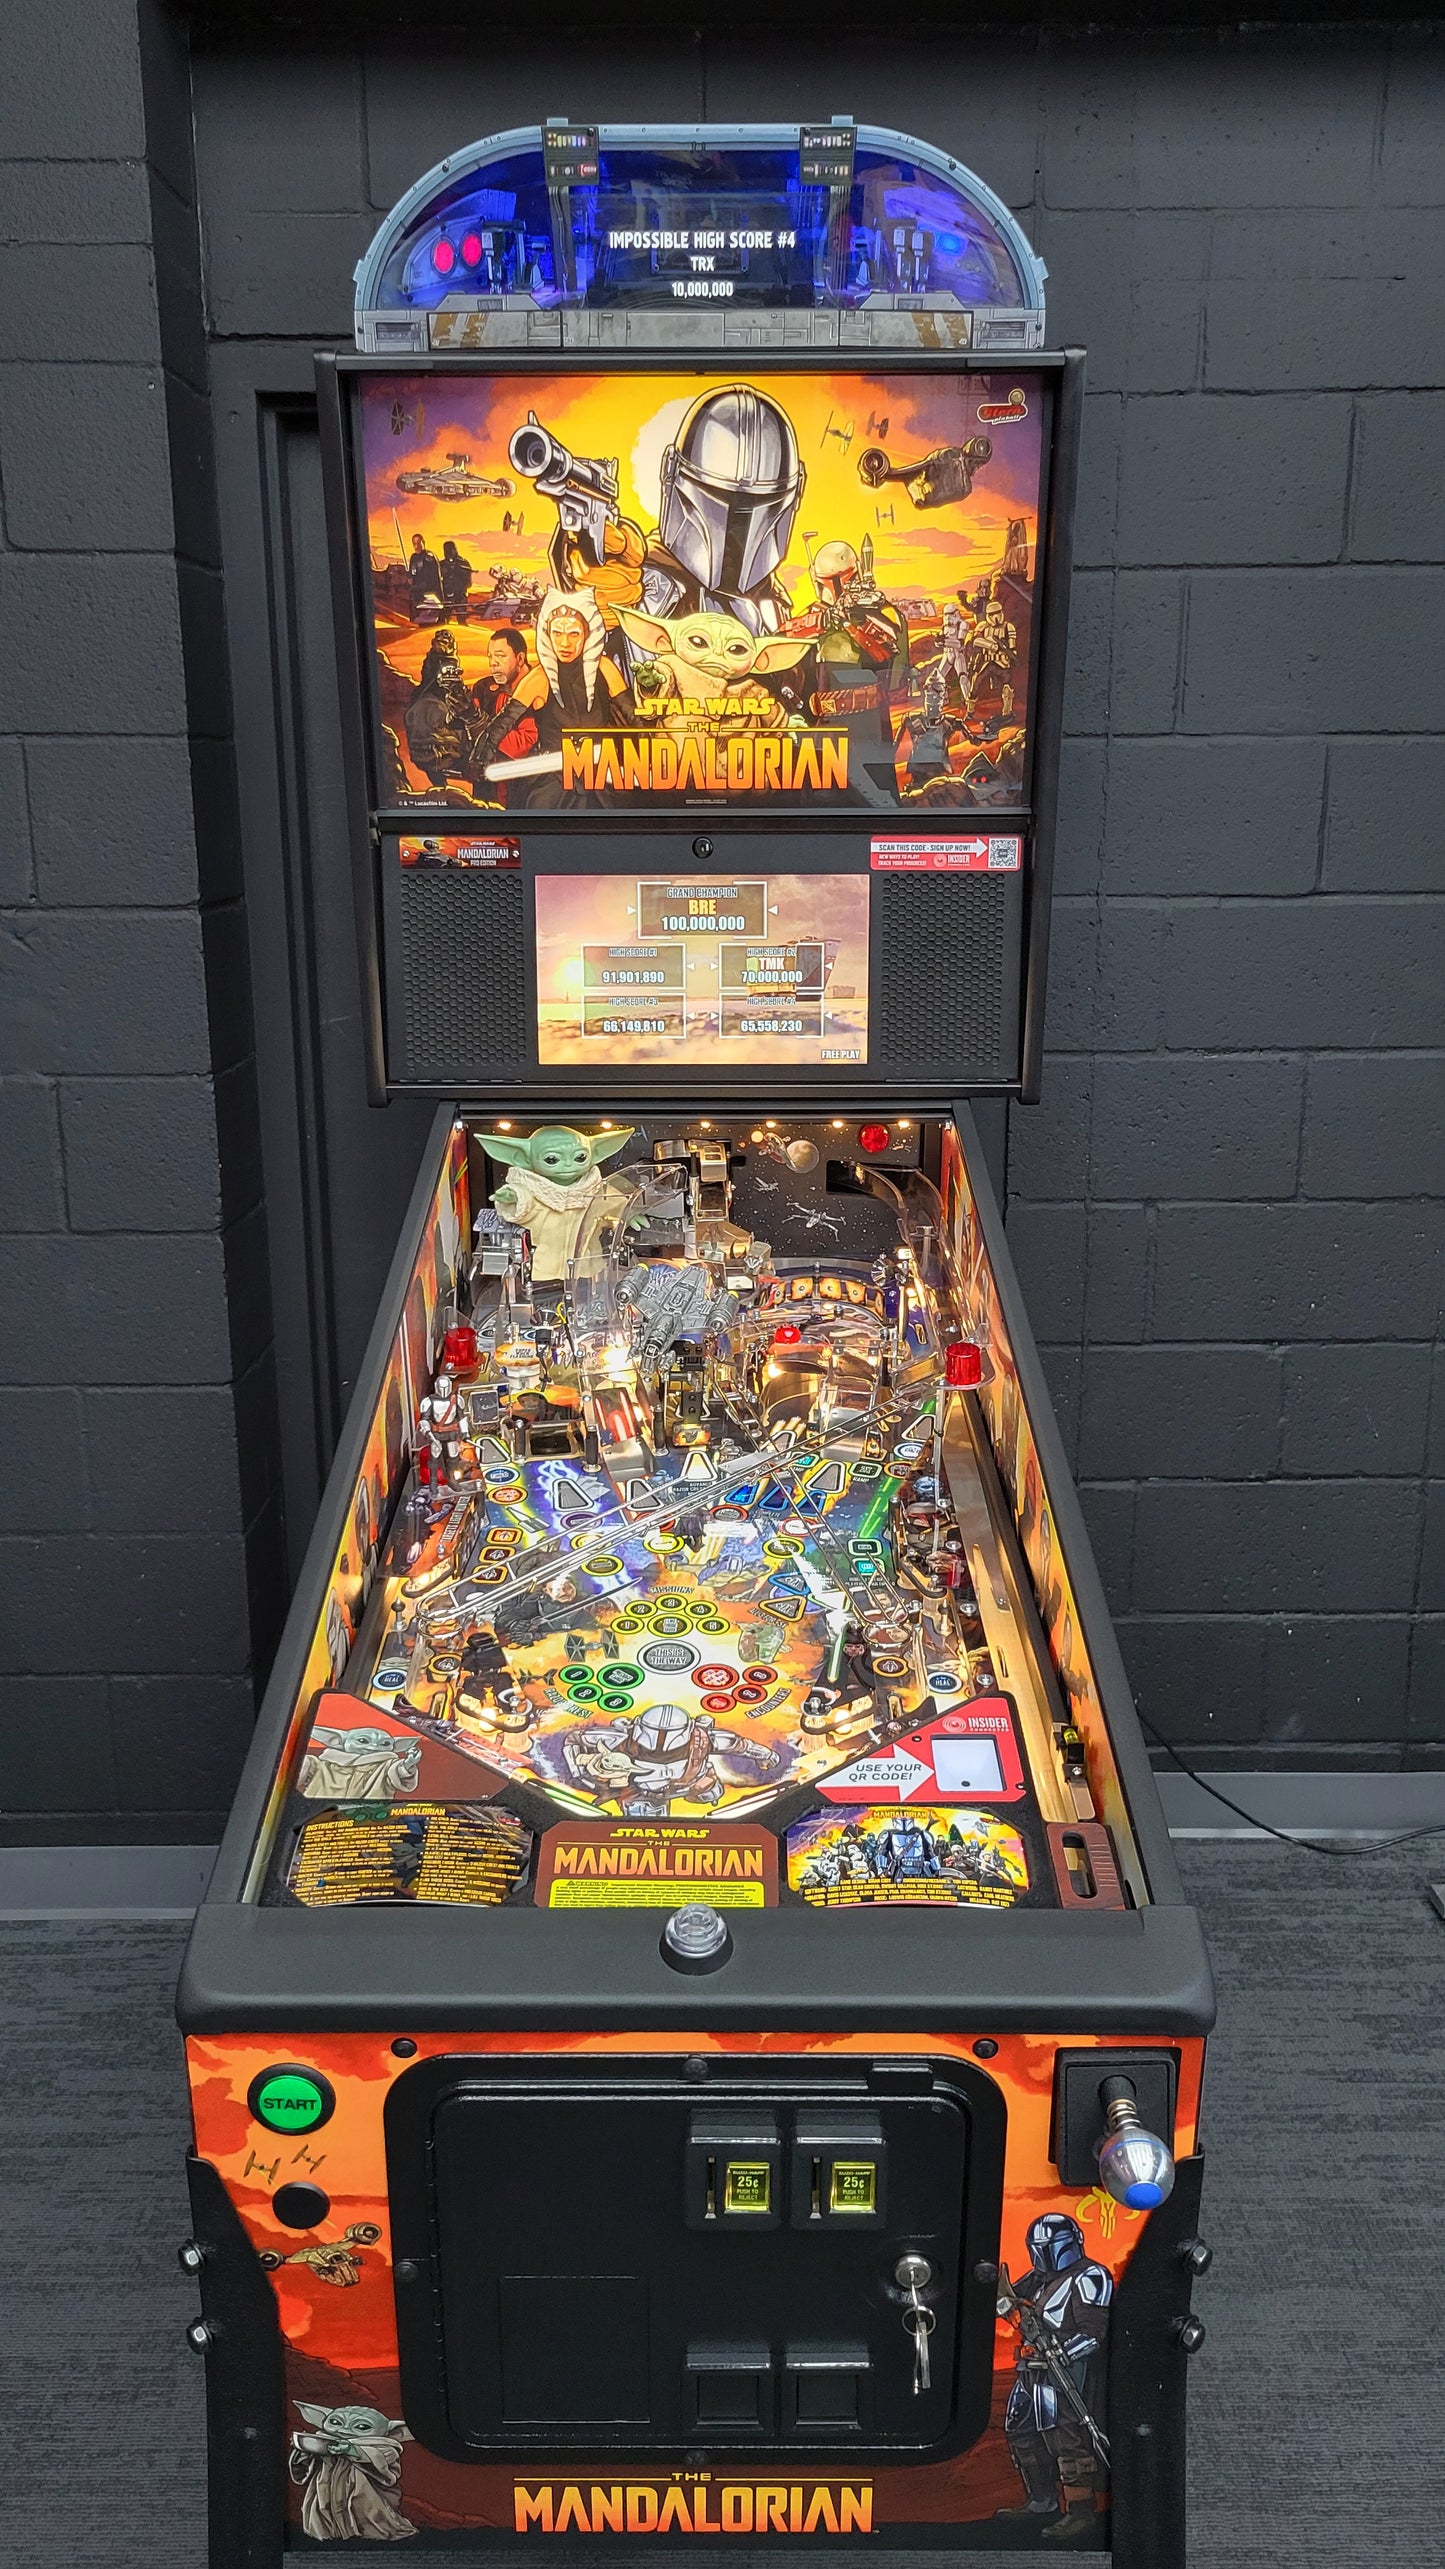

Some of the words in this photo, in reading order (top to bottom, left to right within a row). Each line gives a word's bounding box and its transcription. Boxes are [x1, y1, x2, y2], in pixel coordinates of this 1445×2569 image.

[609, 231, 689, 249] IMPOSSIBLE
[694, 231, 725, 249] HIGH
[729, 231, 773, 249] SCORE
[777, 231, 796, 249] #4
[690, 256, 715, 271] TRX
[671, 281, 734, 298] 10,000,000
[634, 697, 704, 716] STAR
[703, 697, 776, 716] WARS
[687, 721, 721, 732] THE
[560, 737, 849, 790] MANDALORIAN
[457, 848, 509, 858] MANDALORIAN
[948, 855, 970, 863] INSIDER
[667, 887, 695, 898] GRAND
[696, 887, 738, 898] CHAMPION
[688, 899, 718, 915] BRE
[661, 916, 745, 932] 100,000,000
[609, 948, 625, 957] HIGH
[626, 948, 648, 957] SCORE
[747, 947, 763, 957] HIGH
[764, 947, 785, 957] SCORE
[759, 957, 785, 970] TMK
[602, 971, 665, 984] 91,901,890
[741, 971, 803, 983] 70,000,000
[609, 997, 625, 1006] HIGH
[626, 997, 647, 1006] SCORE
[747, 996, 763, 1006] HIGH
[764, 996, 785, 1006] SCORE
[603, 1020, 665, 1033] 66,149,810
[740, 1019, 803, 1033] 65,558,230
[821, 1050, 840, 1059] FREE
[841, 1050, 860, 1059] PLAY
[651, 1656, 668, 1665] THE
[668, 1656, 687, 1665] WAY
[745, 1687, 792, 1719] ENCOUNTERS
[968, 1717, 1009, 1728] INSIDER
[856, 1764, 882, 1772] USE
[886, 1763, 922, 1771] YOUR
[848, 1773, 867, 1782] QR
[872, 1772, 913, 1780] CODE!
[390, 1807, 446, 1816] MANDALORIAN
[306, 1820, 355, 1831] INSTRUCTIONS
[610, 1829, 660, 1838] STAR
[661, 1829, 711, 1839] WARS
[553, 1847, 764, 1877] MANDALORIAN
[263, 2097, 318, 2111] START
[737, 2176, 759, 2188] 25¢
[843, 2176, 865, 2188] 25¢
[671, 2472, 712, 2481] THE
[513, 2486, 873, 2533] MANDALORIAN
